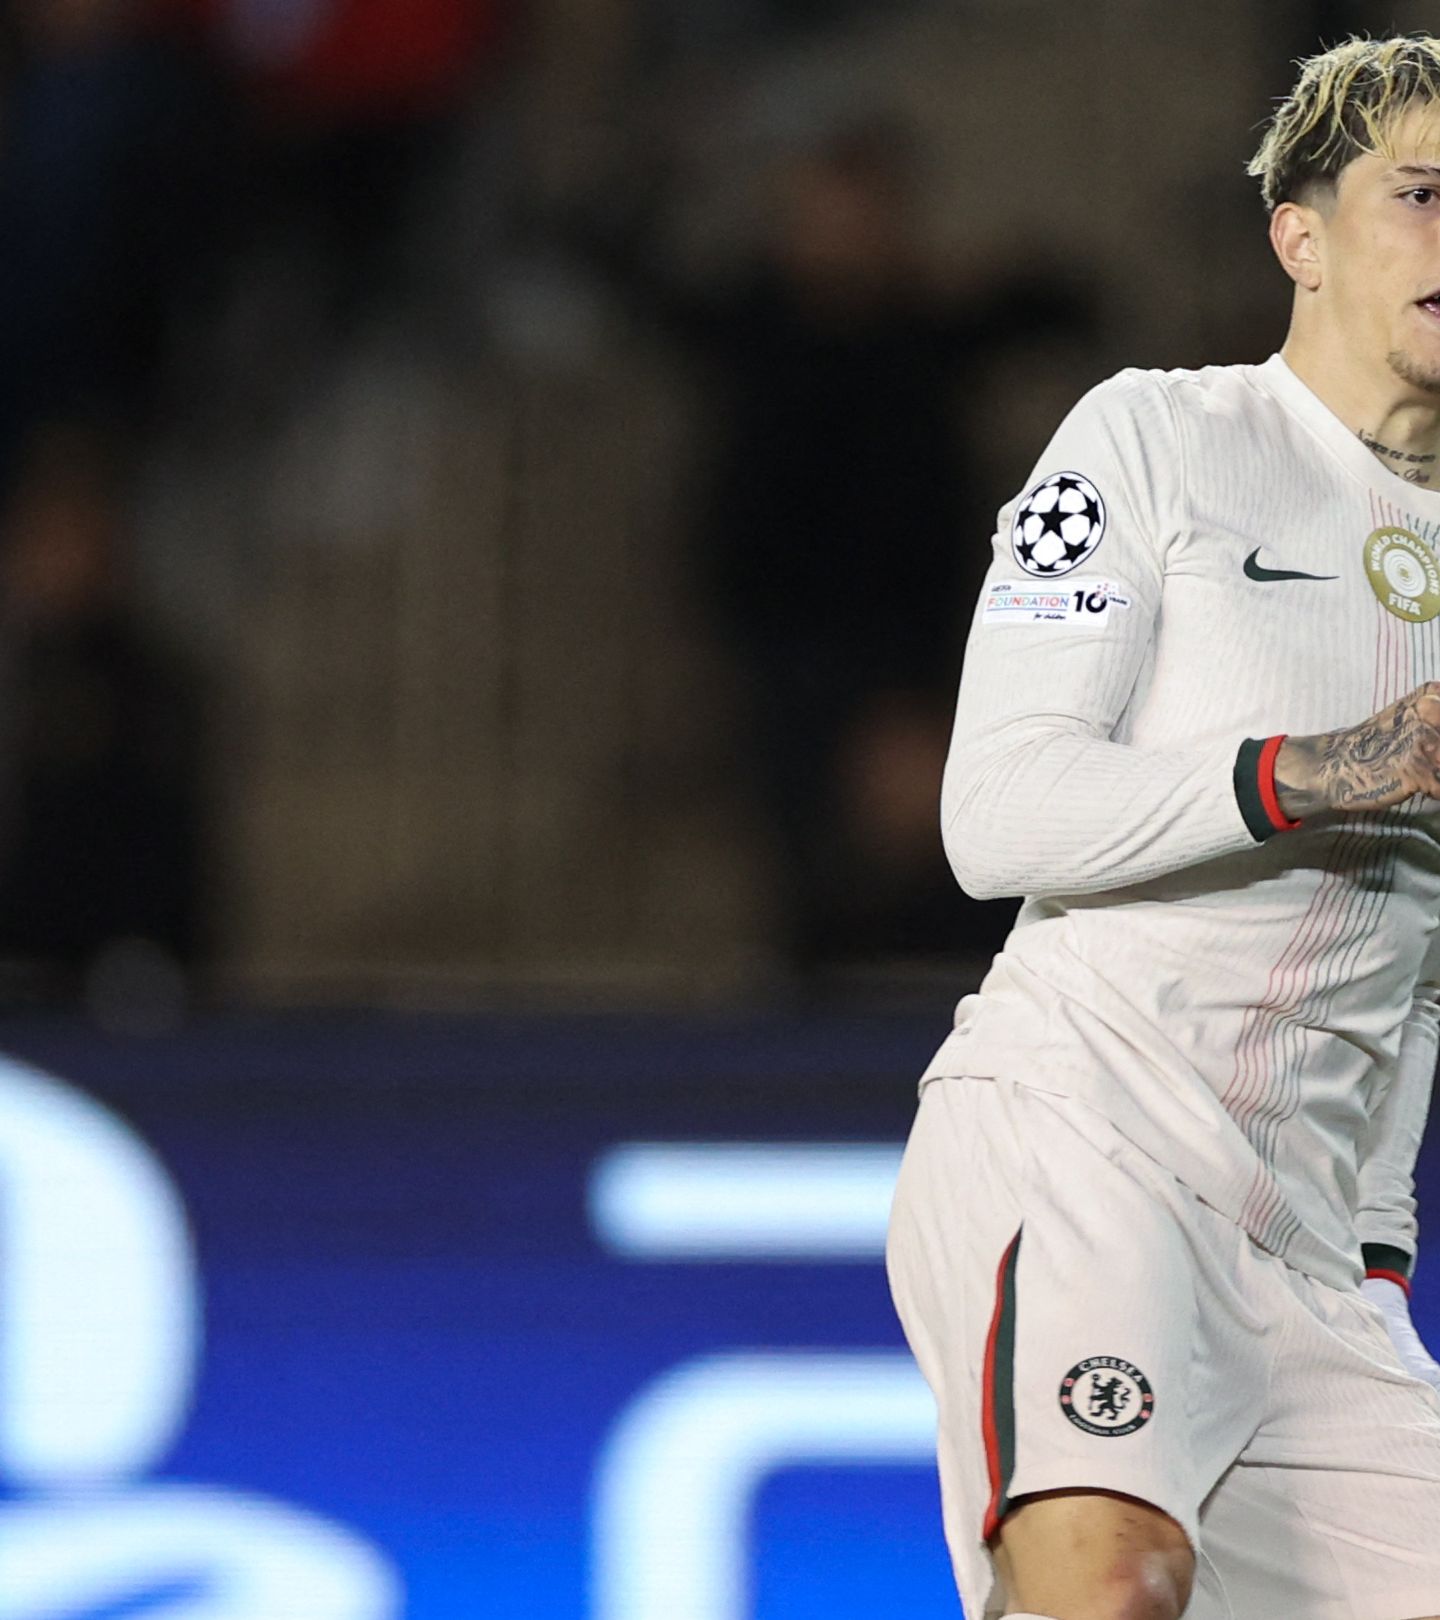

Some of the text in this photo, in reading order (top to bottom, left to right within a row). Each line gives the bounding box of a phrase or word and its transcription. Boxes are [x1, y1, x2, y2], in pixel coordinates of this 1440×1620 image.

[1371, 534, 1440, 596] WORLD CHAMPIONS
[987, 596, 1070, 608] FOUNDATION
[1073, 590, 1108, 613] 10
[1388, 593, 1421, 616] FIFA
[1078, 1357, 1145, 1383] CHELSEA
